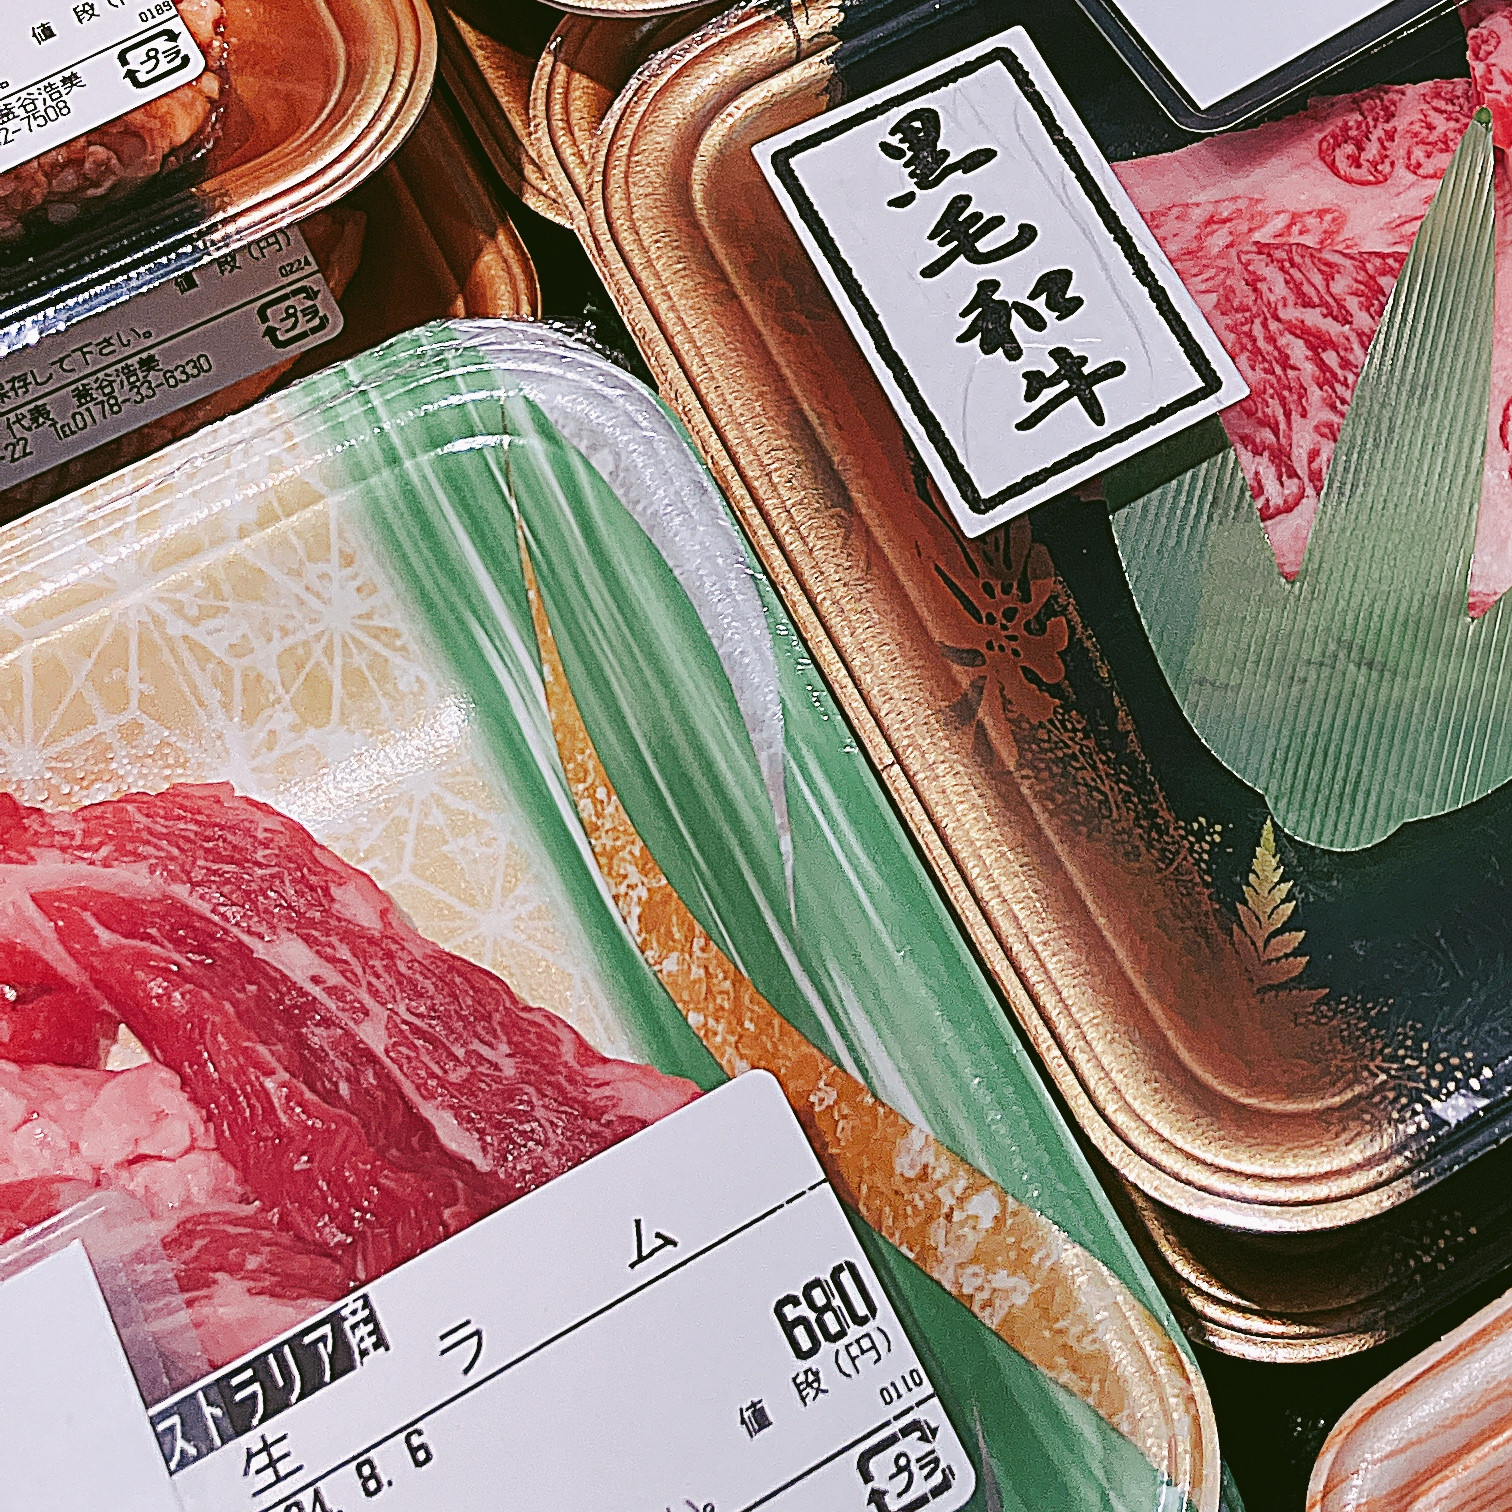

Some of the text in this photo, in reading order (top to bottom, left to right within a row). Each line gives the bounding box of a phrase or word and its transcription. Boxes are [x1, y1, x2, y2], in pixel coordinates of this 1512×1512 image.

[0, 100, 71, 145] 2-7508
[279, 258, 312, 278] 0224
[878, 107, 1127, 431] 黒毛和牛
[6, 403, 52, 439] 代表
[773, 1259, 877, 1360] 680
[879, 1368, 924, 1408] 0110
